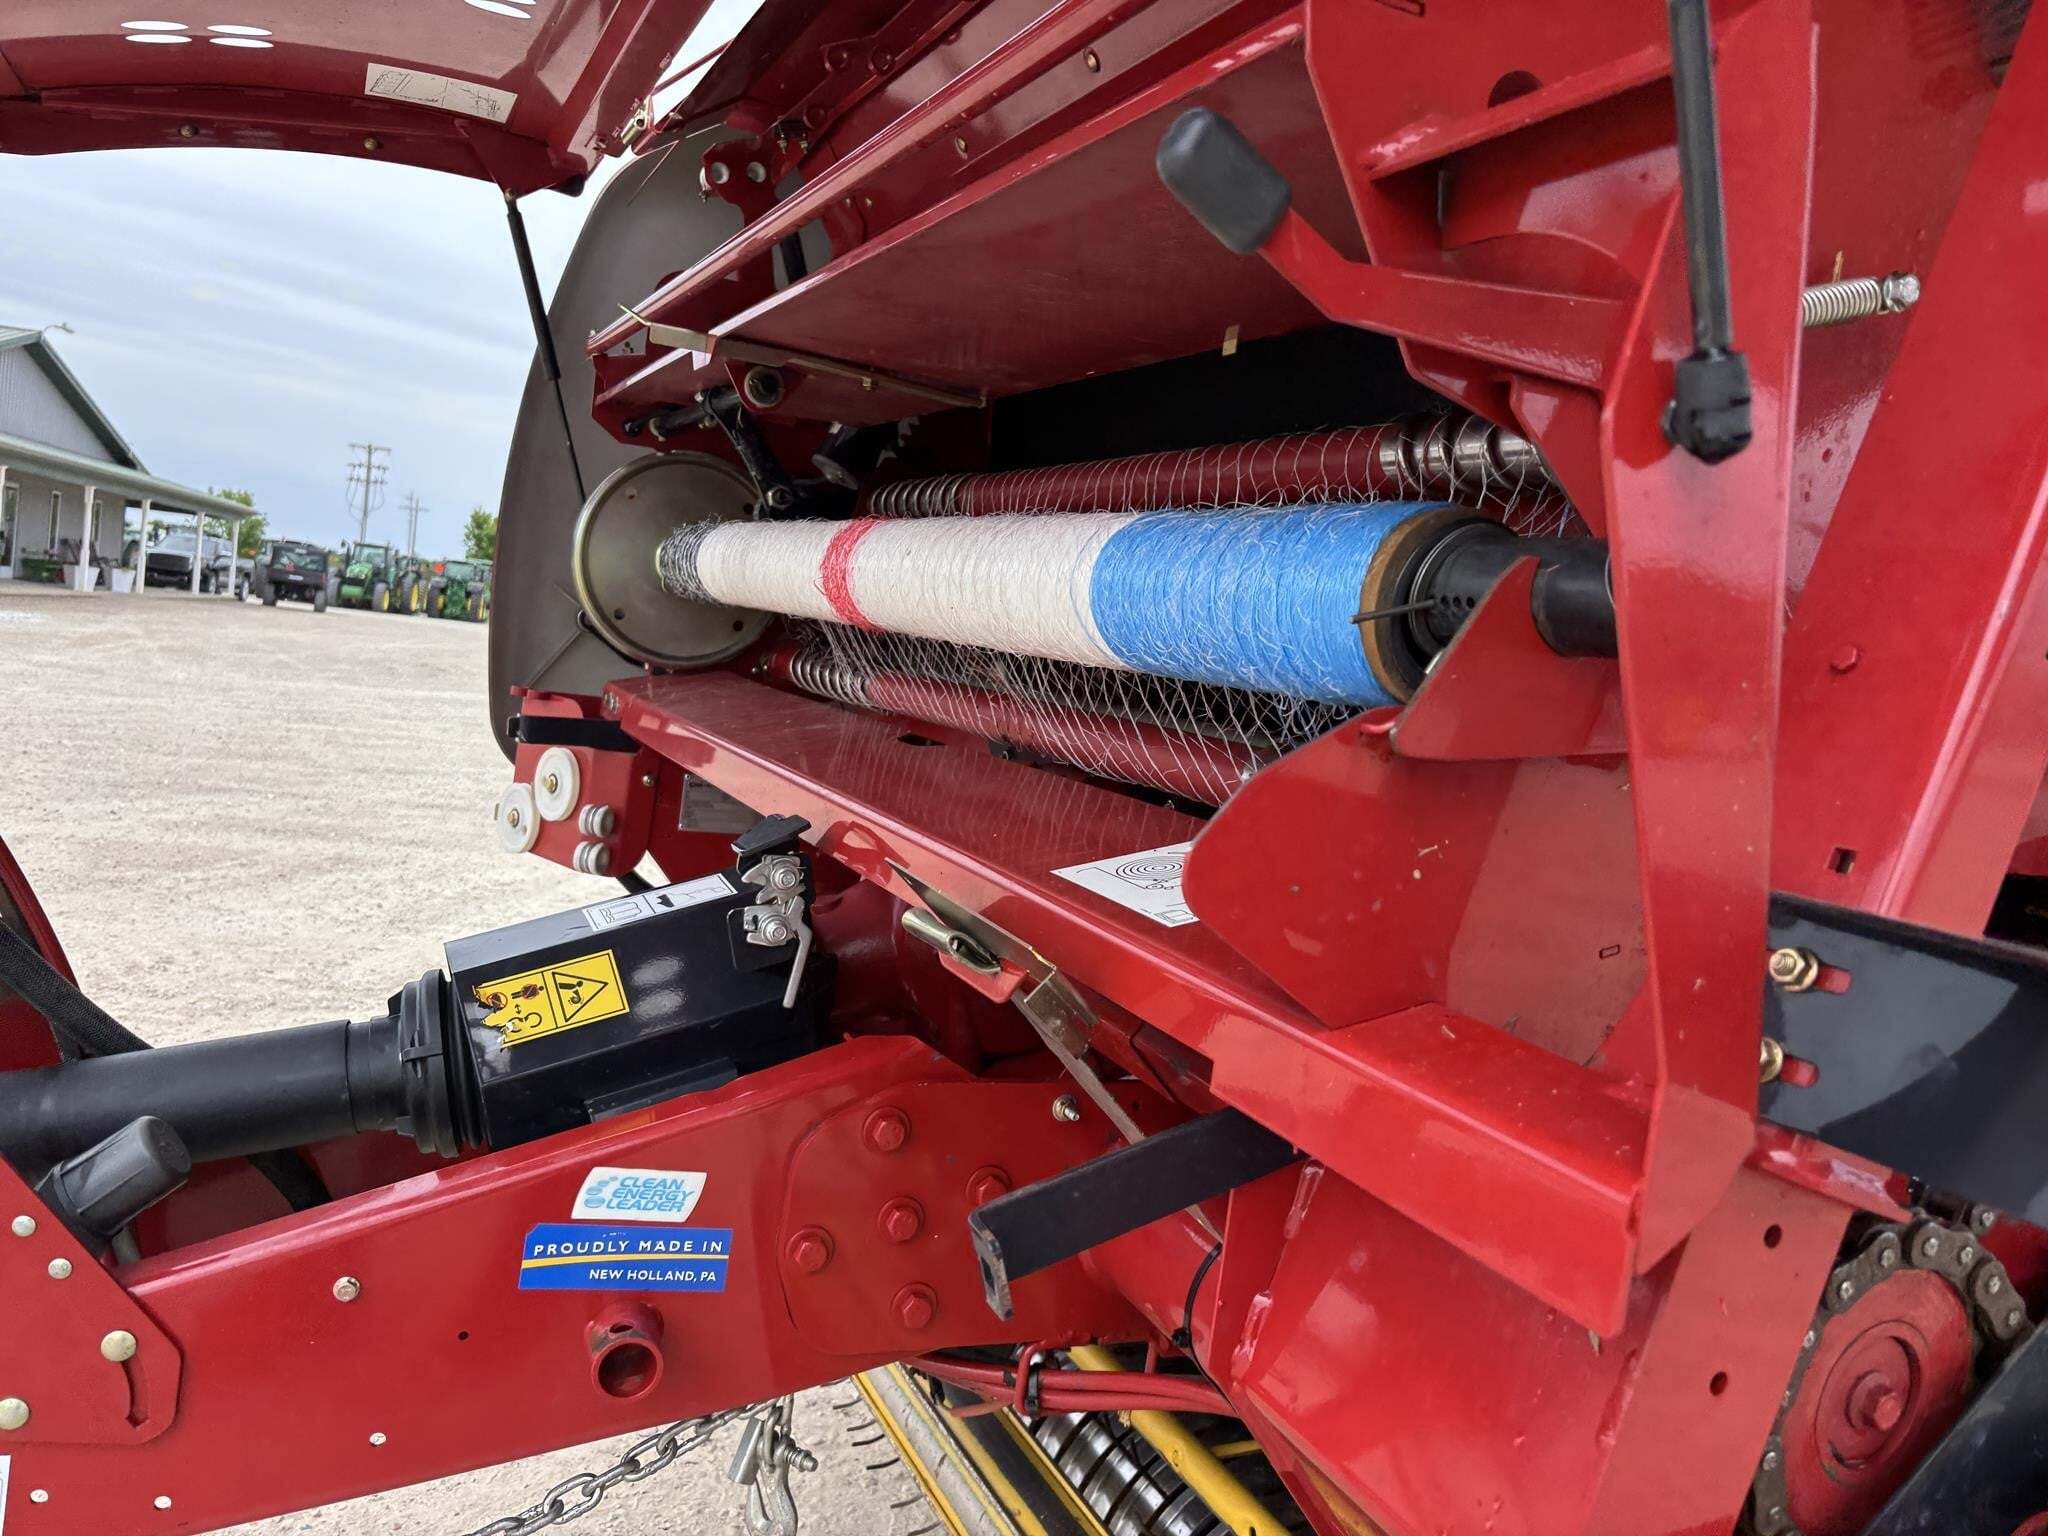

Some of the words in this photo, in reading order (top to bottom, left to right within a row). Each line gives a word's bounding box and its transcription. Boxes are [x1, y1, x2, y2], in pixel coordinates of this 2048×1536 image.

[619, 1176, 685, 1190] CLEAN
[612, 1187, 695, 1201] ENERGY
[606, 1198, 685, 1212] LEADER
[533, 1240, 630, 1256] PROUDLY
[638, 1240, 694, 1252] MADE
[702, 1241, 723, 1252] IN
[589, 1269, 624, 1280] NEW
[627, 1269, 697, 1282] HOLLAND,
[700, 1271, 717, 1281] PA
